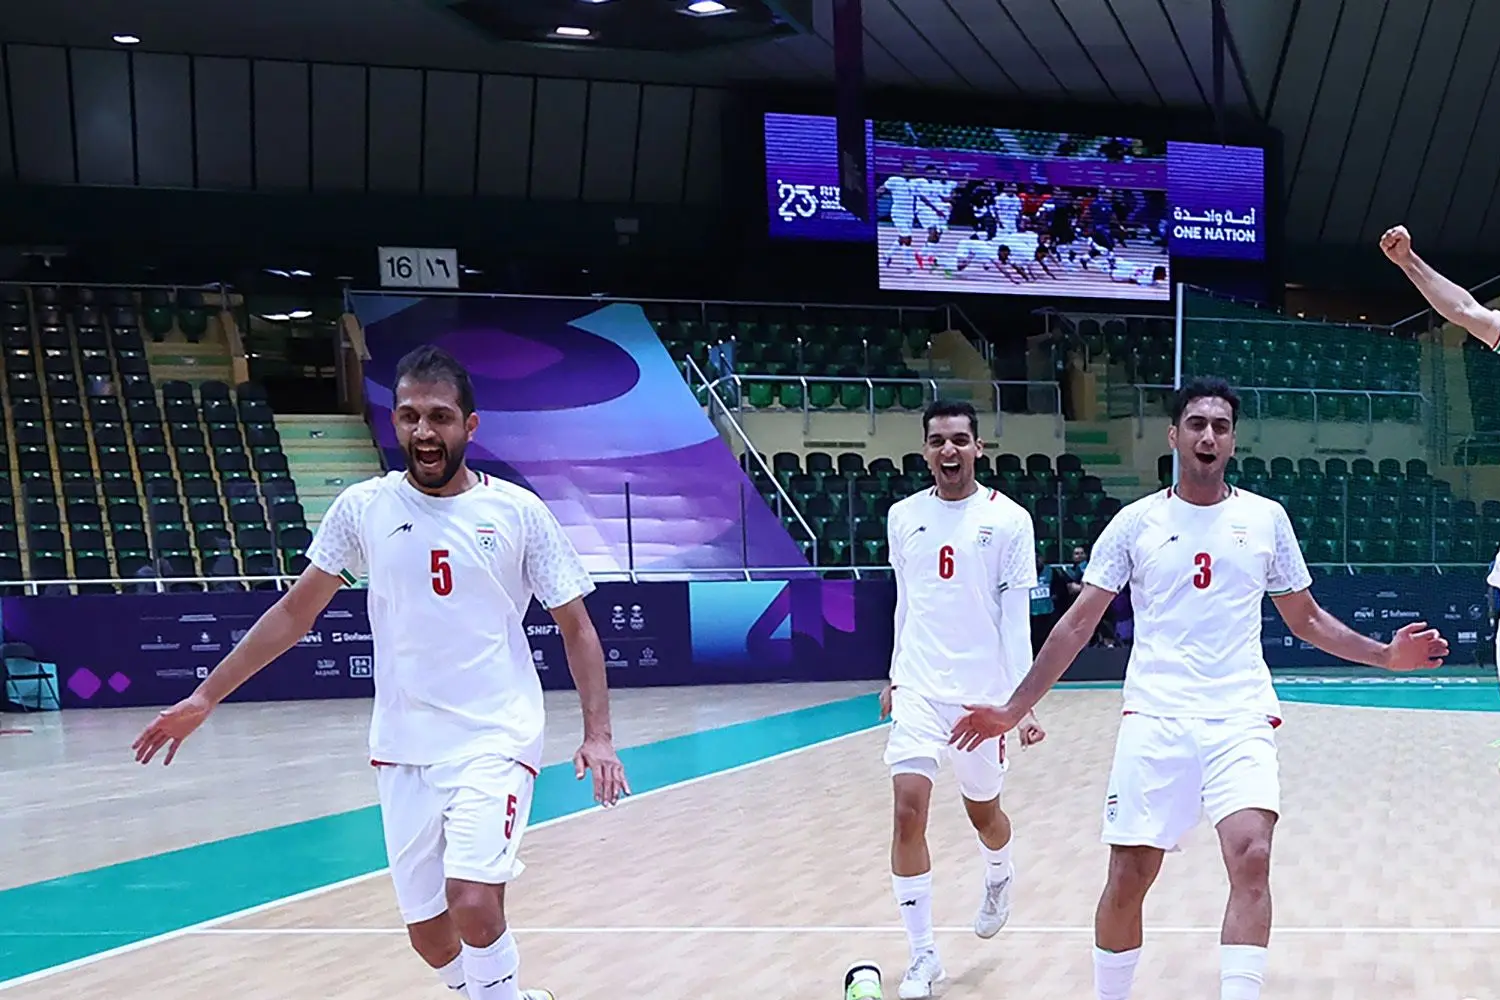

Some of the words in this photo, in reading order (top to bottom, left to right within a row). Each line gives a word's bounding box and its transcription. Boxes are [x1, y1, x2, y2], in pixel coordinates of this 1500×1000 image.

[1173, 225, 1202, 239] ONE
[1204, 226, 1256, 242] NATION
[387, 256, 413, 278] 16
[426, 258, 450, 278] ١٦
[430, 549, 453, 596] 5
[939, 545, 954, 579] 6
[1193, 552, 1211, 589] 3
[505, 794, 517, 840] 5
